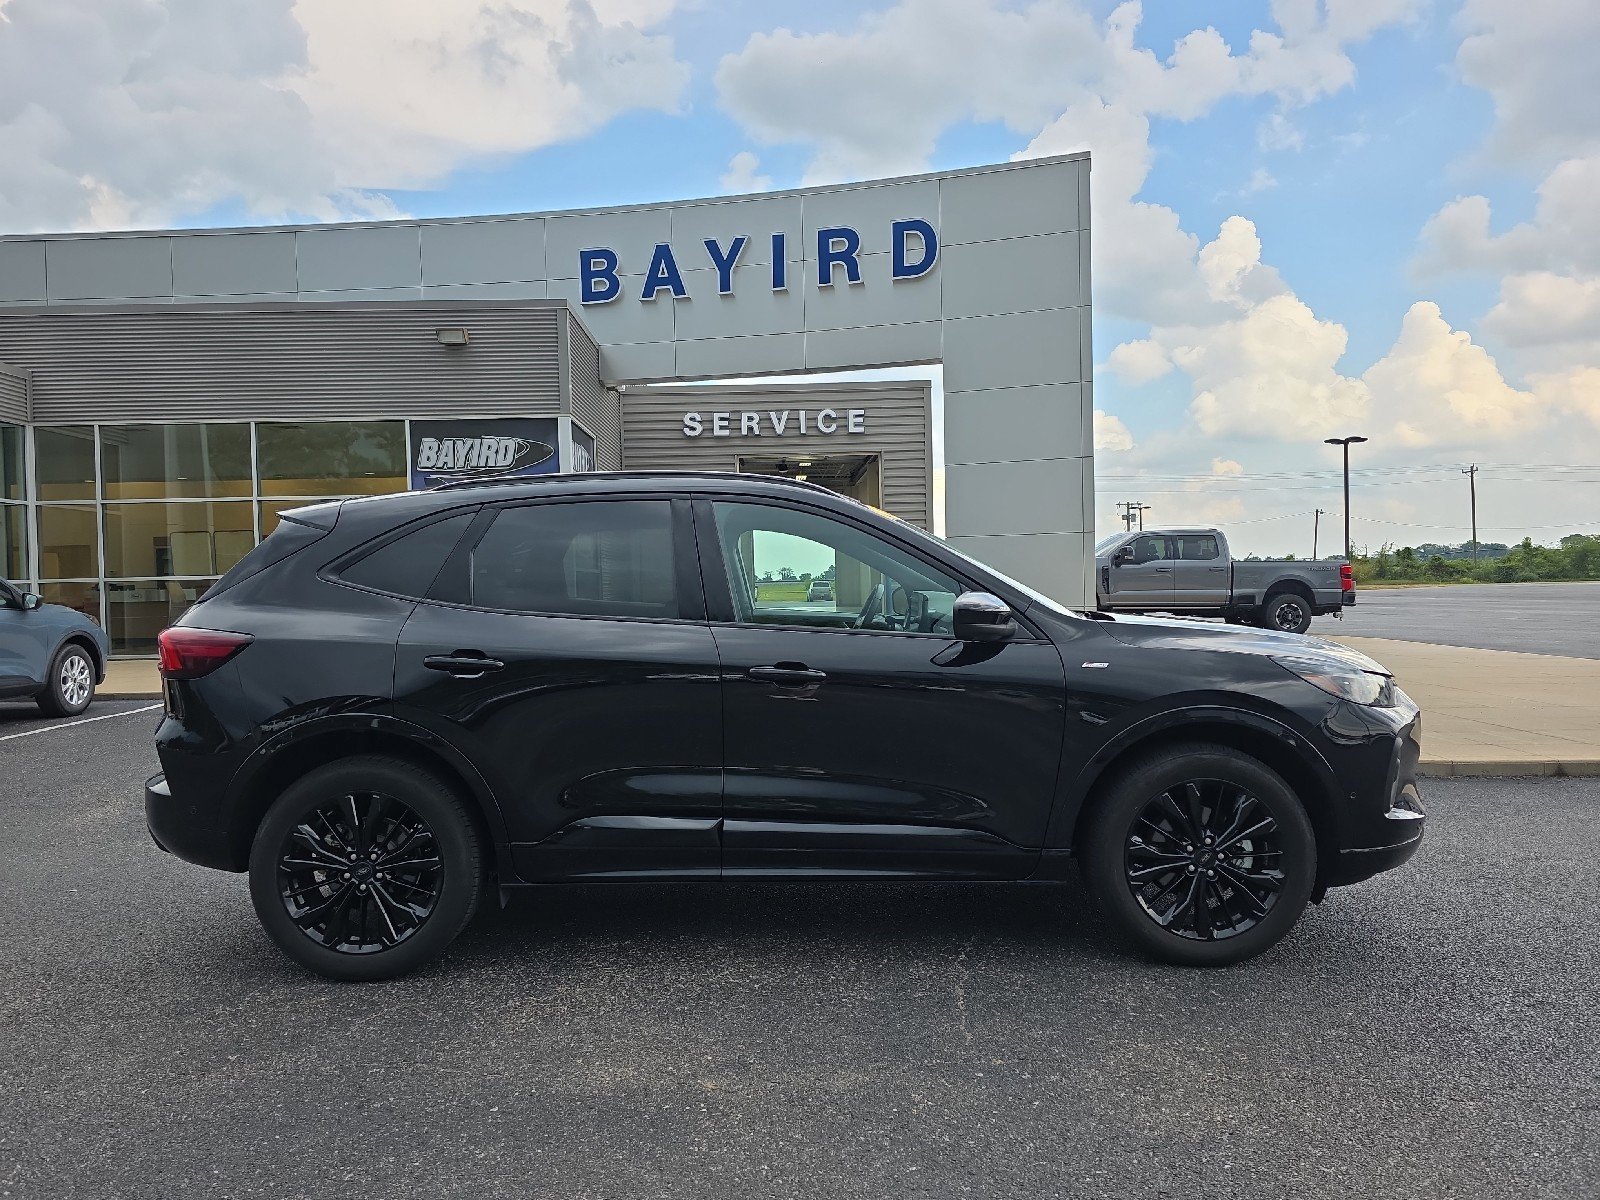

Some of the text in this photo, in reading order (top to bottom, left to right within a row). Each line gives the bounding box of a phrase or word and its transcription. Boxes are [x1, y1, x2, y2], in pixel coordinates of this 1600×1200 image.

[579, 217, 940, 305] BAYIRD
[683, 408, 865, 437] SERVICE
[417, 436, 517, 471] BAYIRD
